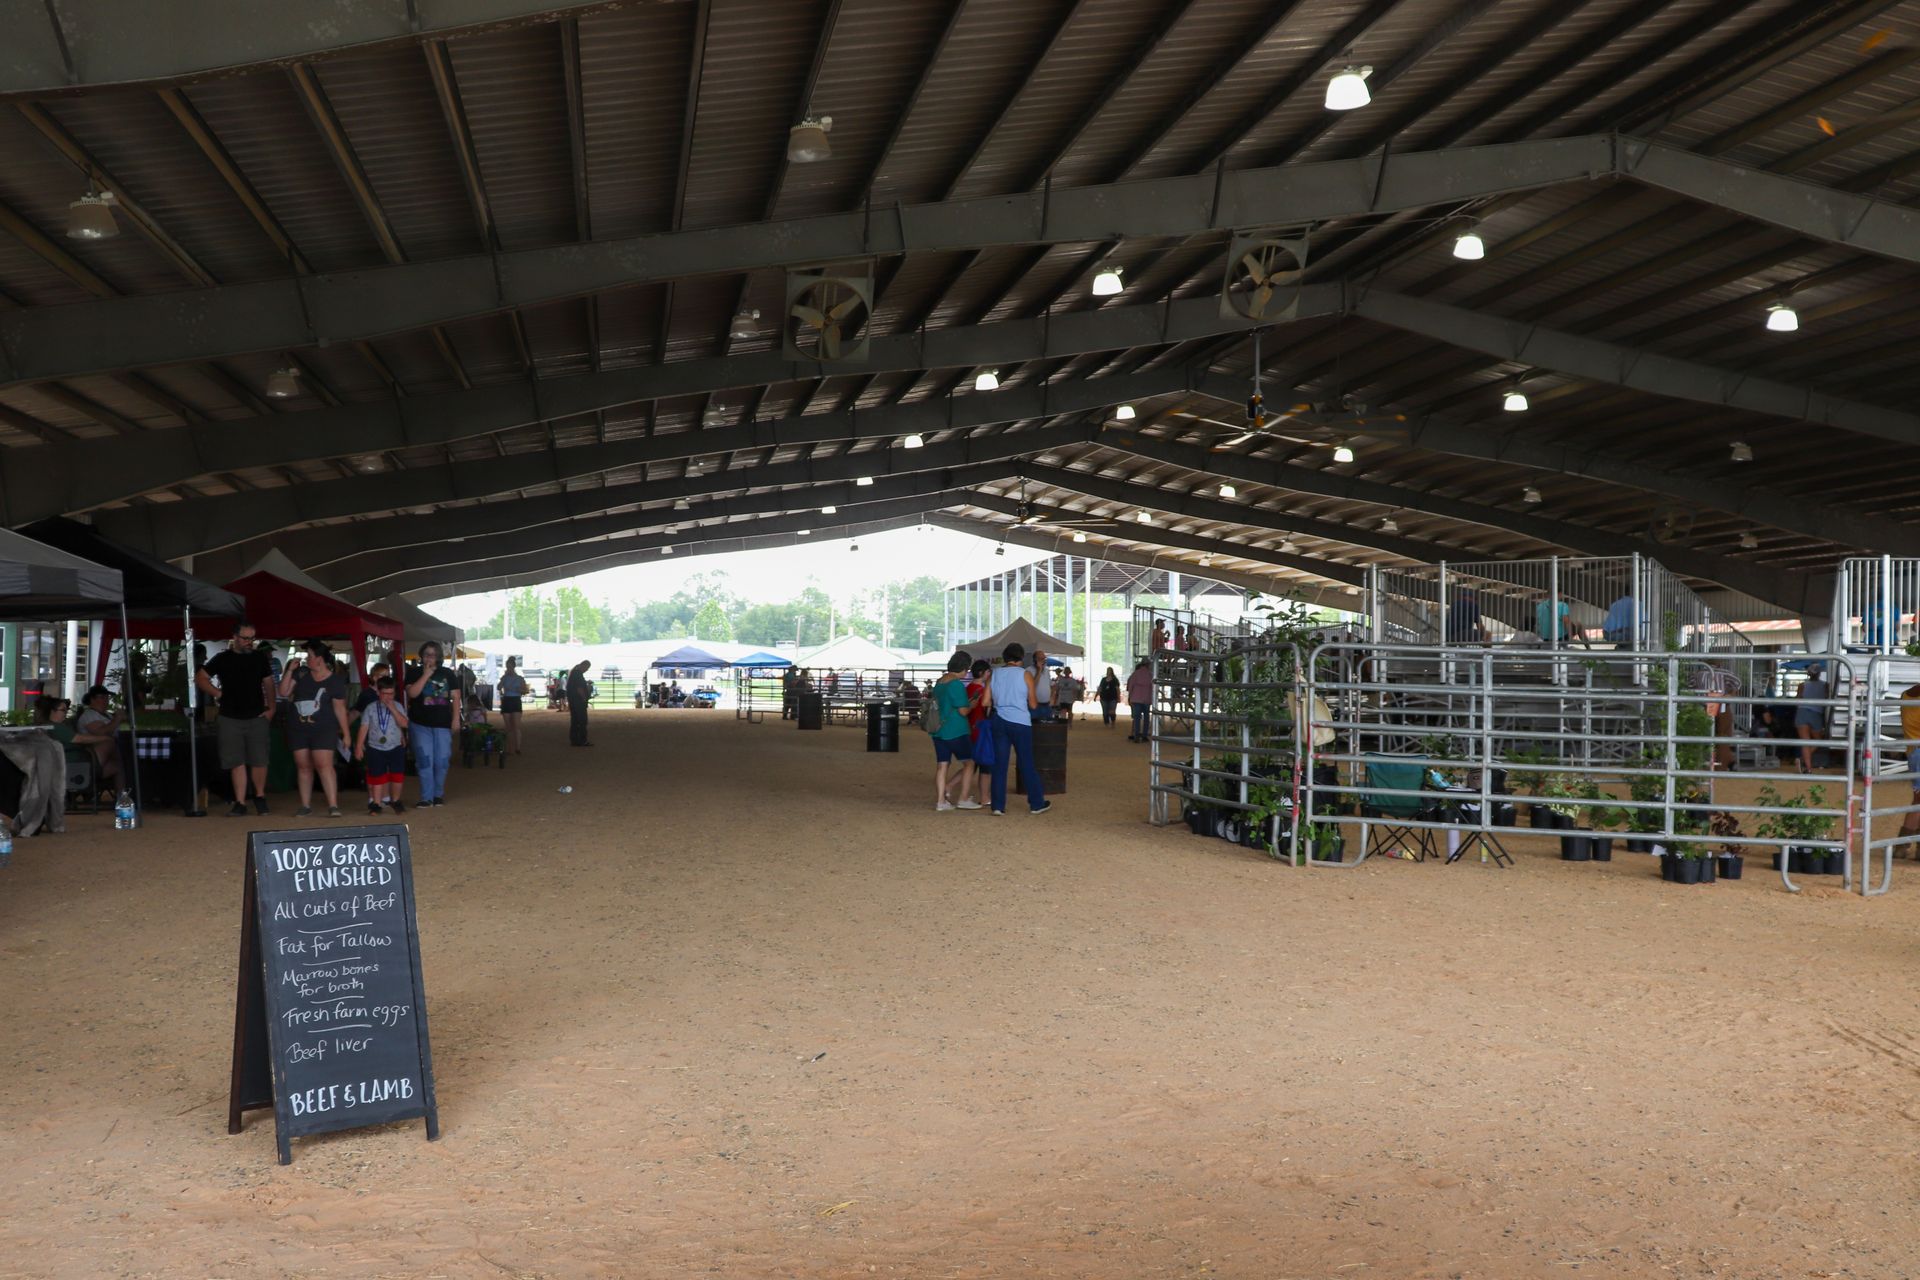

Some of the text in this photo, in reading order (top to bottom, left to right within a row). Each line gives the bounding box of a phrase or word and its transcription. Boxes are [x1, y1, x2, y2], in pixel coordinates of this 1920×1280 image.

[271, 843, 397, 872] 100% GRASS
[294, 866, 392, 892] FINISHED
[274, 892, 396, 920] All cuts of Beef
[276, 932, 392, 957] Fat for Tallow
[282, 964, 379, 986] Marrow bones
[297, 978, 364, 997] for broth
[282, 1001, 410, 1027] Fresh farm eggs
[285, 1038, 373, 1063] Beef liver
[289, 1078, 414, 1116] BEEF & LAMB
